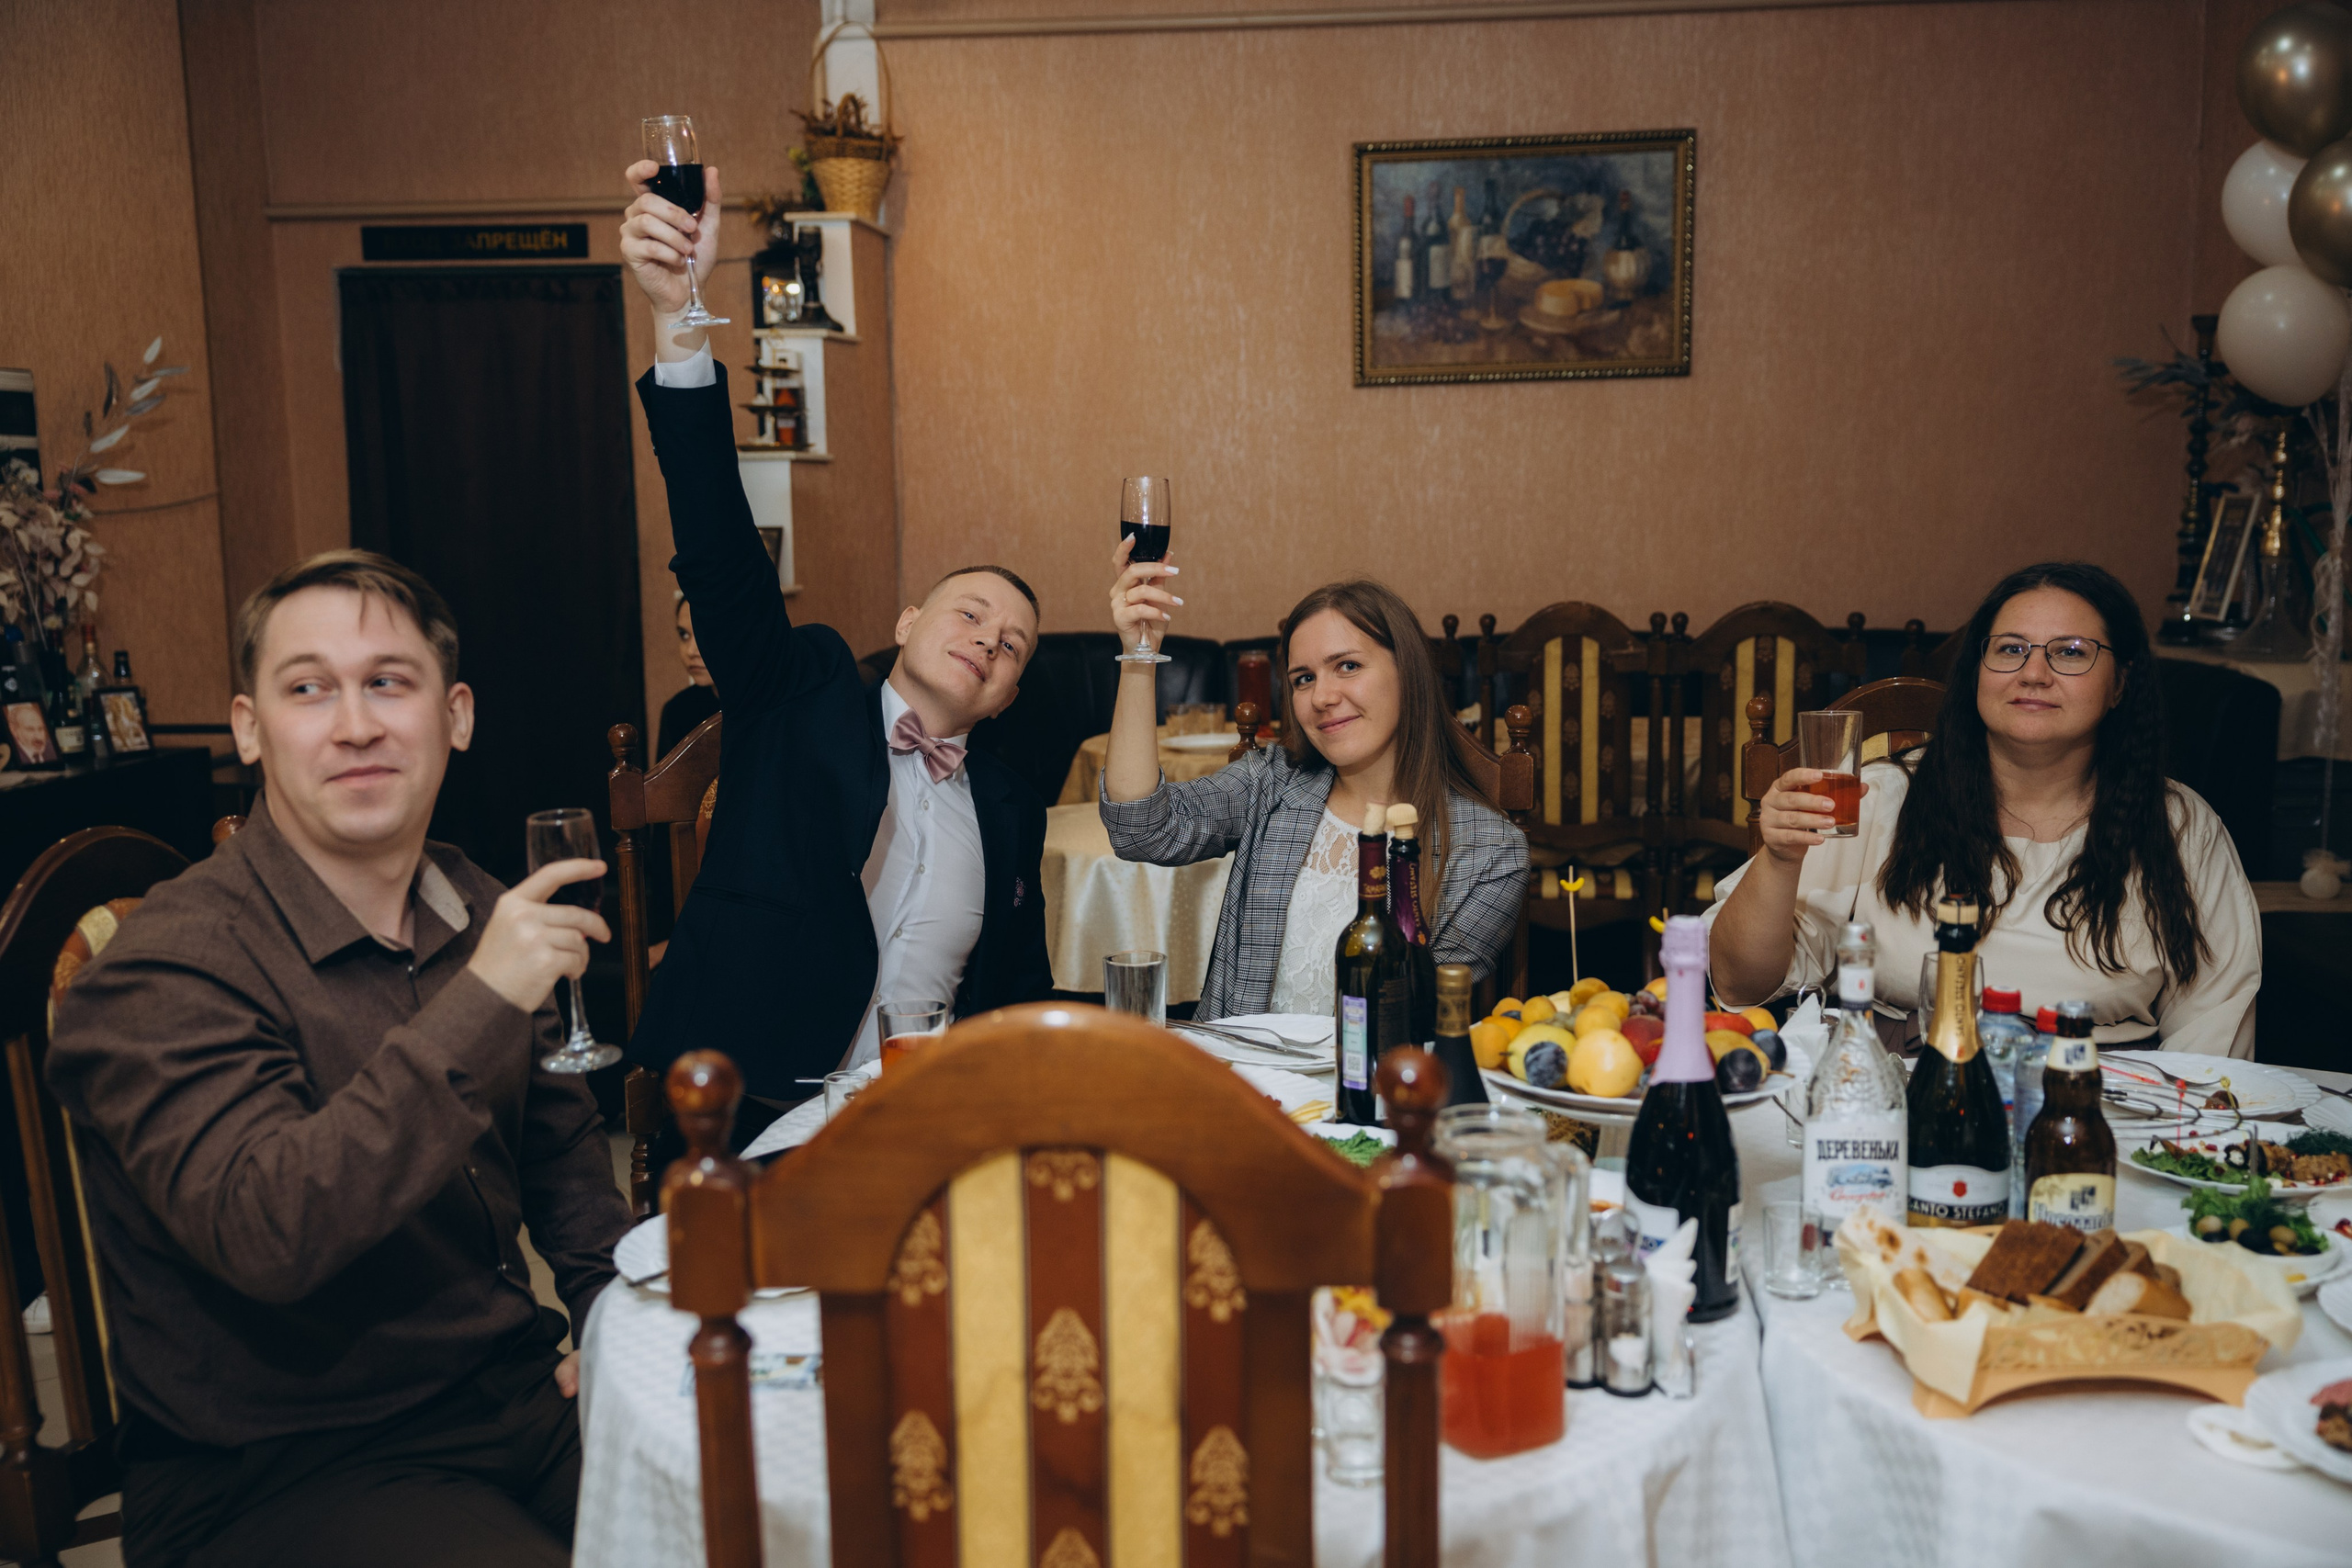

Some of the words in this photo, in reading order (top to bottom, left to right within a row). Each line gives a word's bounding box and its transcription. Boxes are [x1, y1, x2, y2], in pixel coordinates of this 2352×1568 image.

[453, 229, 568, 252] ЗАПРЕЩЁН
[1955, 956, 1965, 1000] STEFANO
[1955, 1004, 1964, 1037] SANTO
[1817, 1140, 1898, 1160] ДЕРЕВЕНЬКА
[1953, 1202, 2004, 1220] STEFANO
